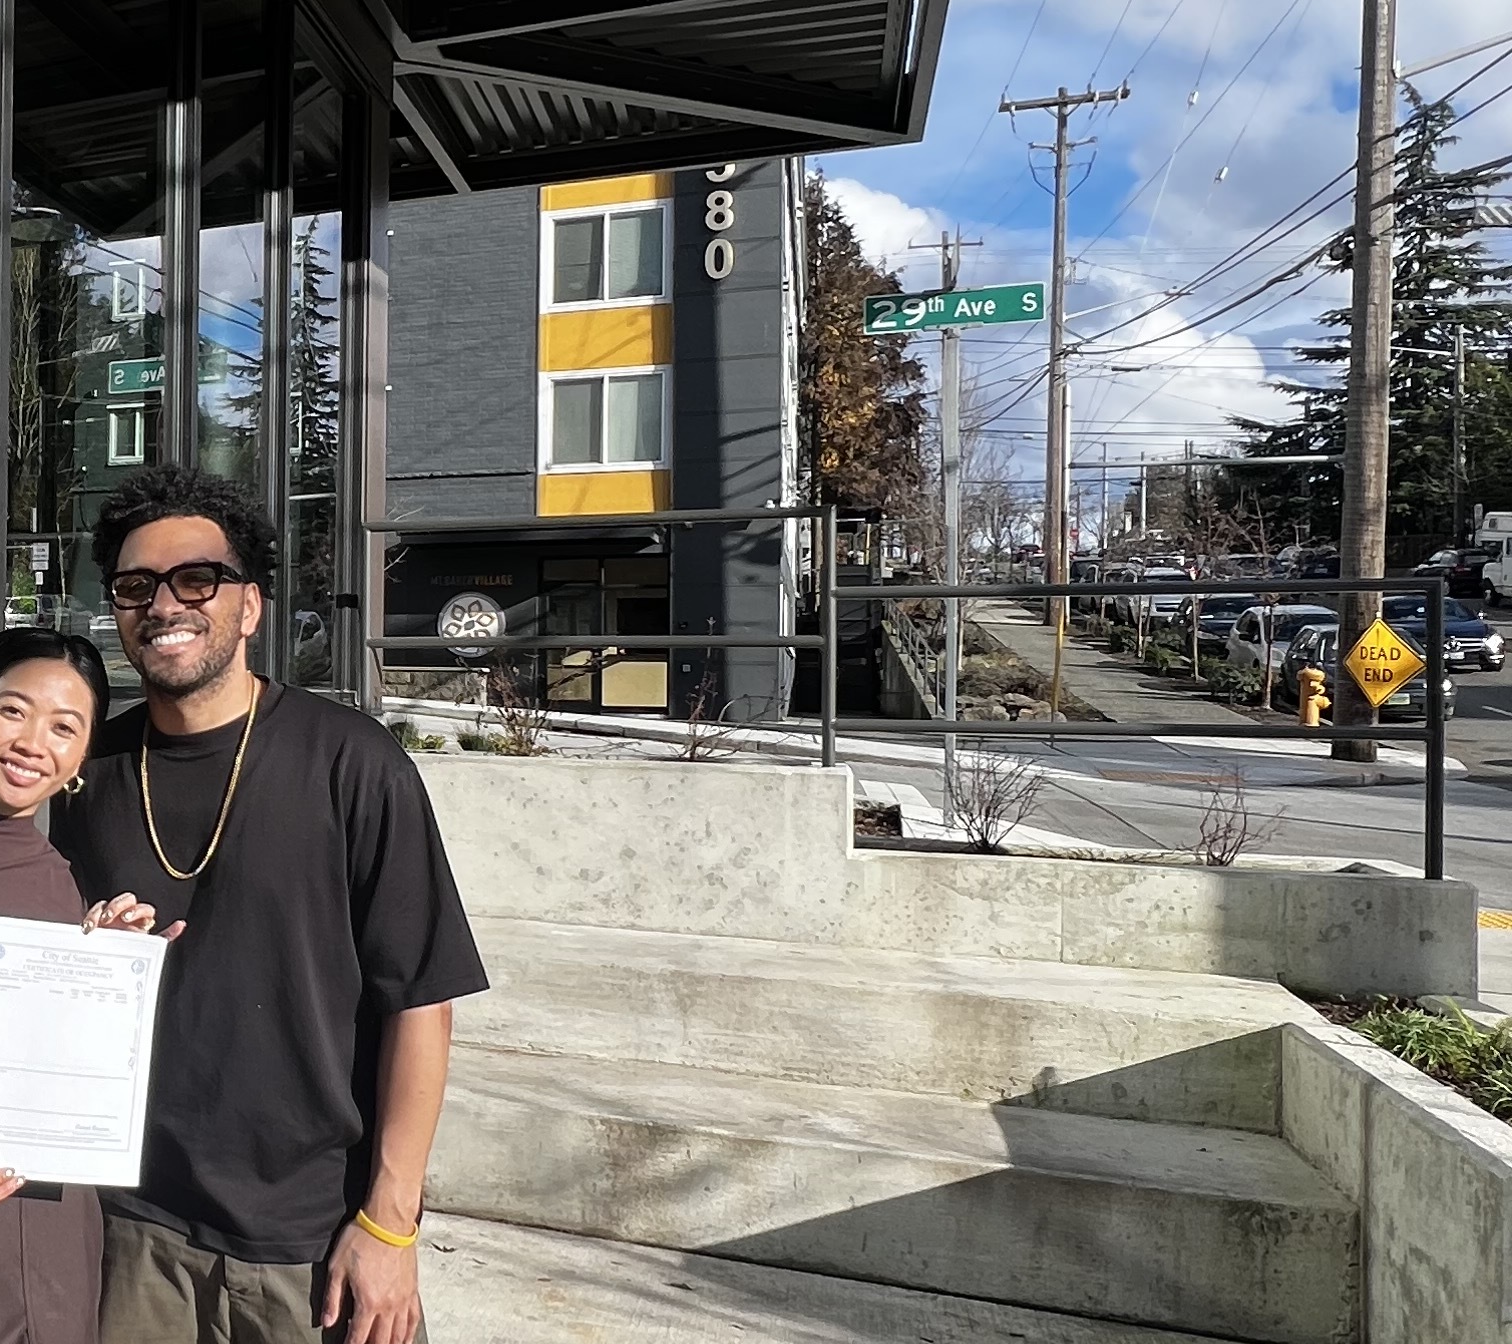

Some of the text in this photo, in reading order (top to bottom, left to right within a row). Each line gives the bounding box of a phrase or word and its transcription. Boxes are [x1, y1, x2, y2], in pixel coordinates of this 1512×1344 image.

[871, 292, 1037, 329] 29th Ave S
[1359, 646, 1401, 661] DEAD
[1364, 667, 1393, 683] END
